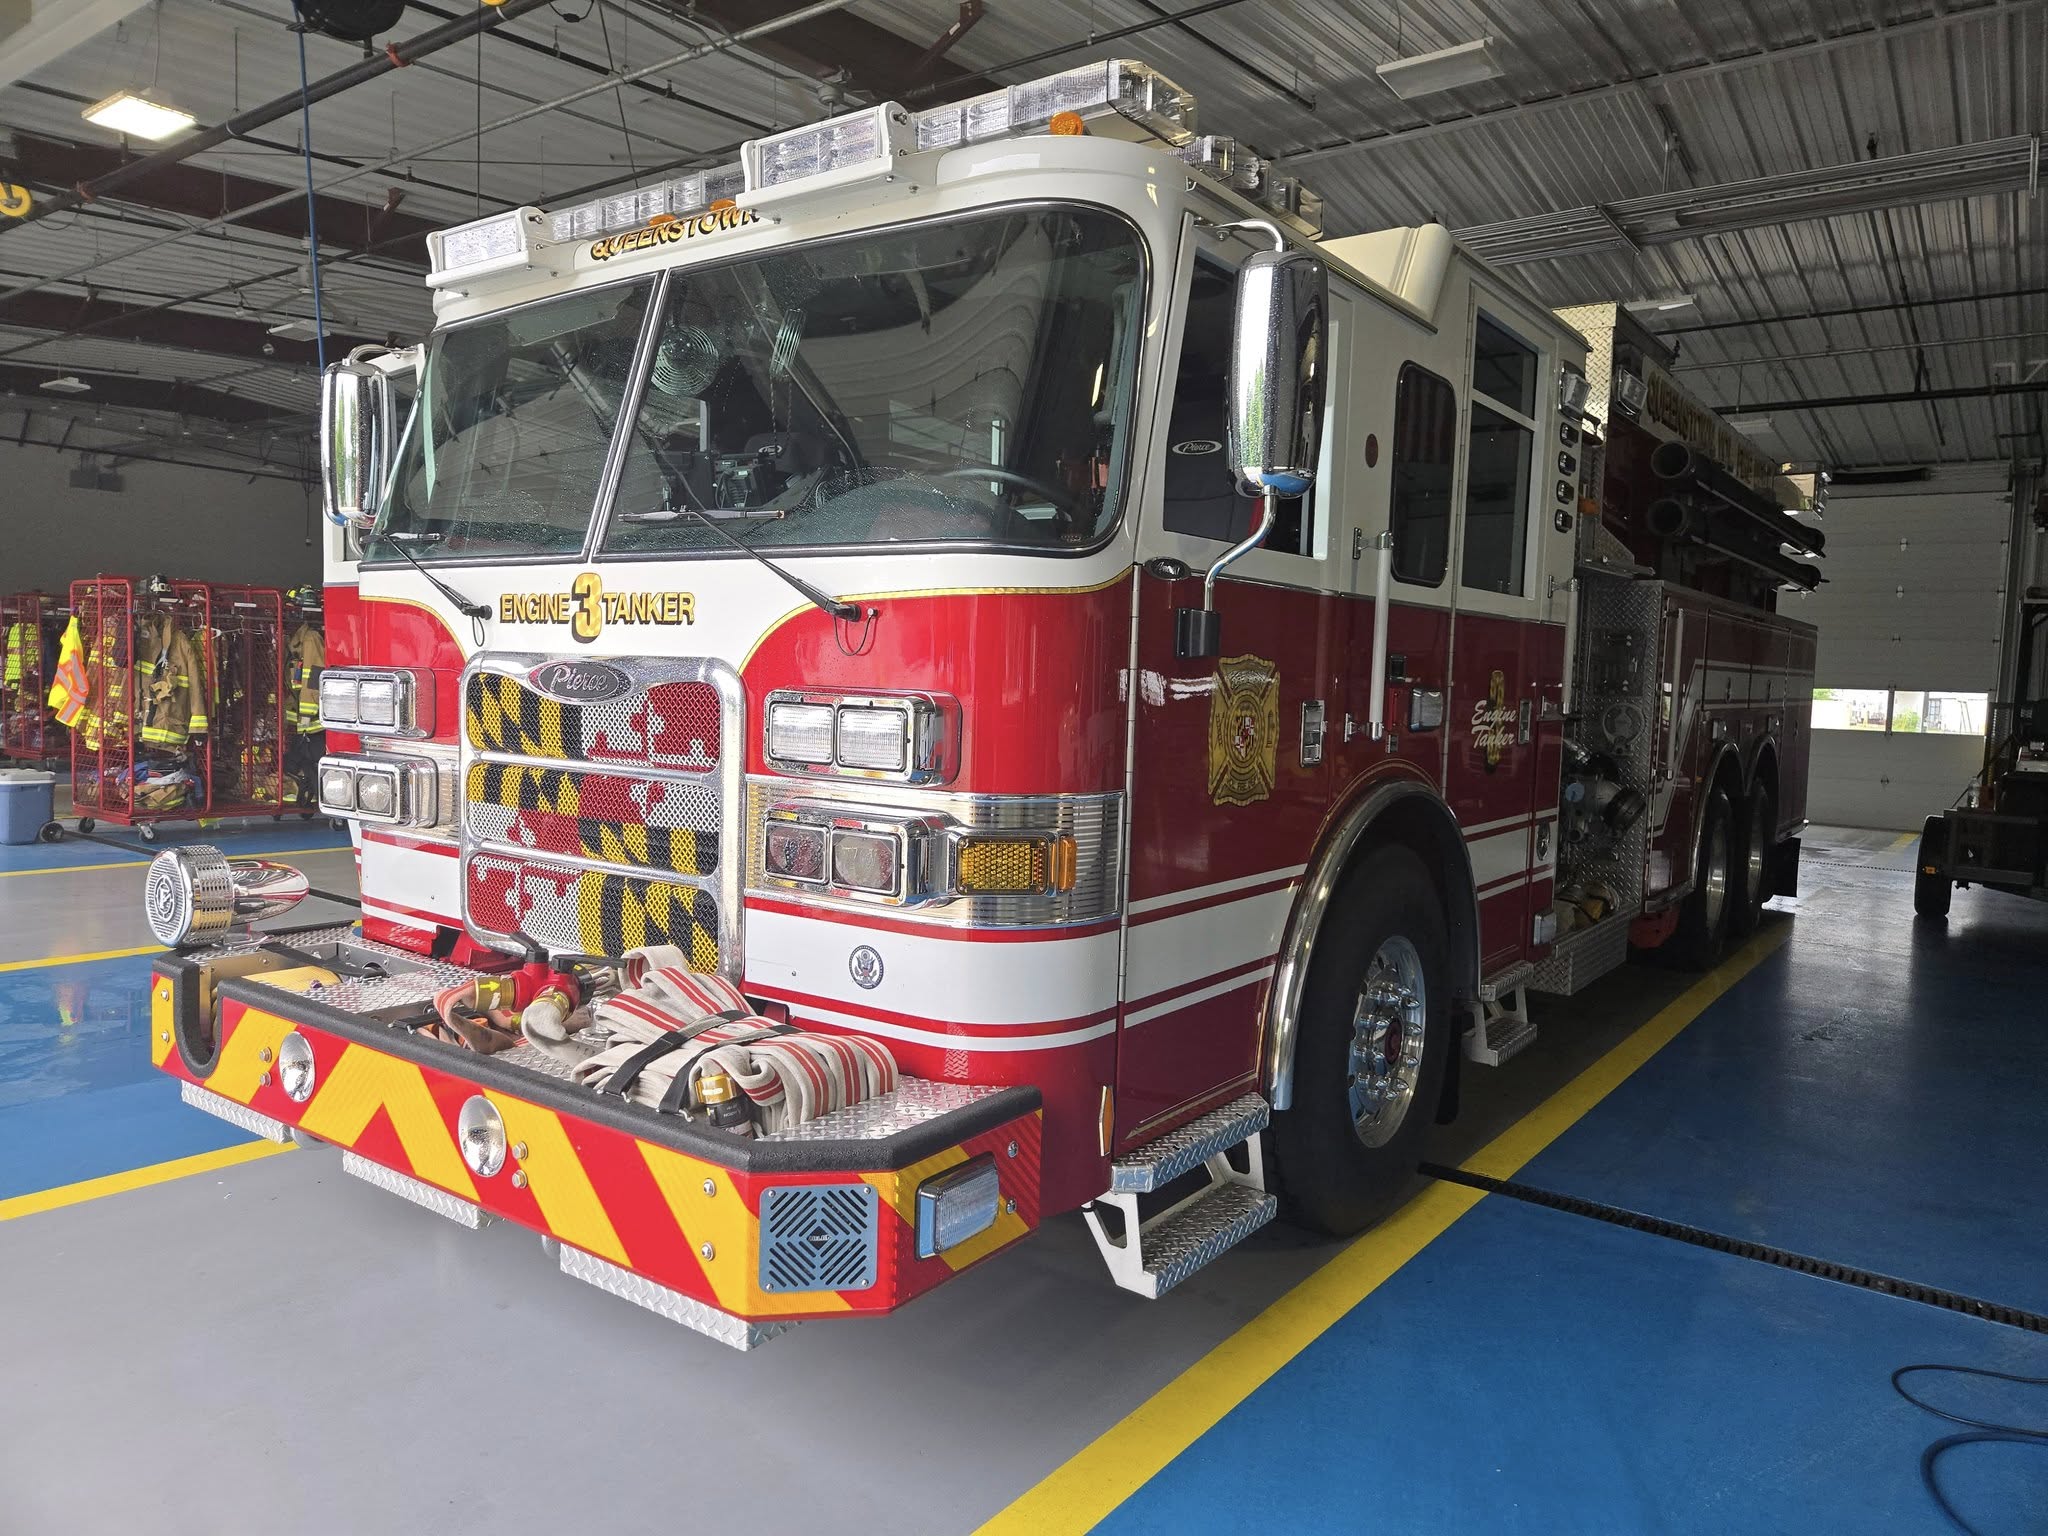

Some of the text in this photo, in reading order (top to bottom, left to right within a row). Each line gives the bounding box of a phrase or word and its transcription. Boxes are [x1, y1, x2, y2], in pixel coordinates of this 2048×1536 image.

[1183, 442, 1211, 453] Pierce
[500, 572, 696, 644] ENGINE 3 TANKER
[550, 664, 610, 694] Pierce
[1471, 699, 1517, 728] Engine
[1471, 725, 1515, 749] Tanker
